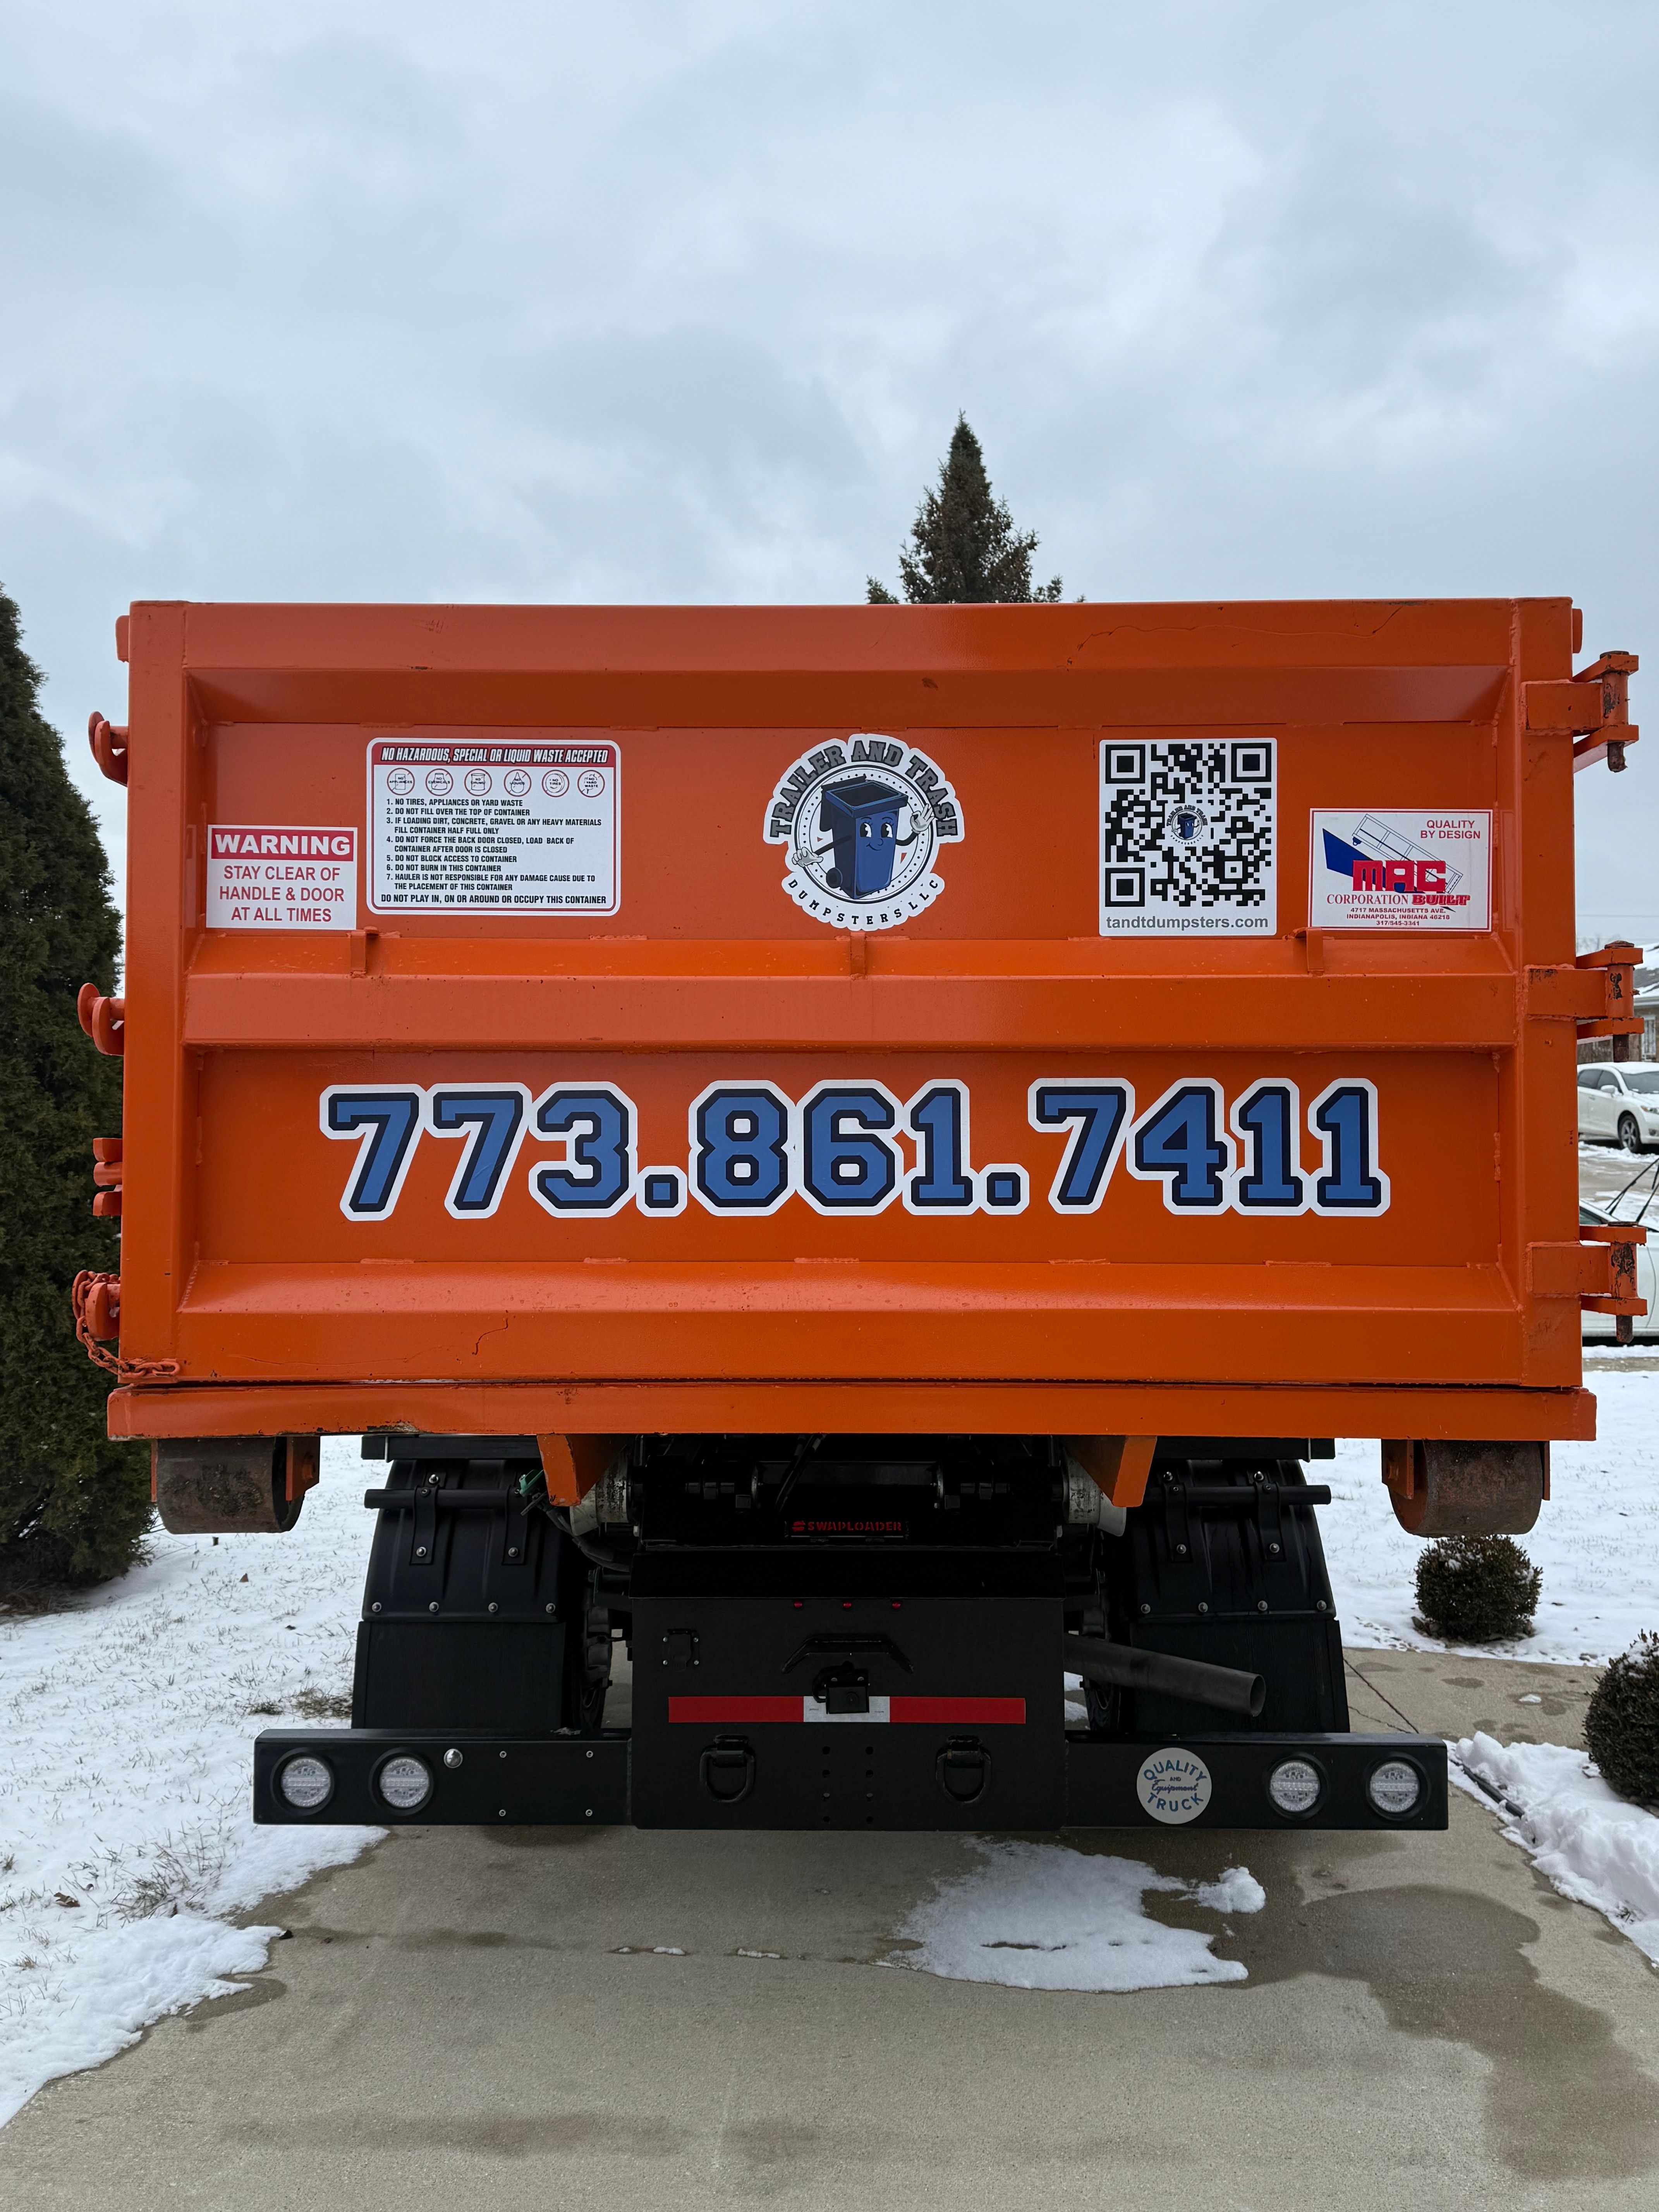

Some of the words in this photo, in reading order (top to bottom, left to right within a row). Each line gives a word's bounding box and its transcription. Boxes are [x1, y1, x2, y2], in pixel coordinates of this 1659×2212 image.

[381, 747, 395, 760] NO
[396, 747, 450, 763] HAZARDOUS,
[453, 749, 487, 761] SPECIAL
[489, 749, 503, 762] OR
[503, 749, 531, 763] LIQUID
[533, 749, 564, 763] WASTE
[565, 749, 608, 763] ACCEPTED
[770, 745, 847, 838] TRAILER
[851, 740, 903, 767] AND
[905, 755, 958, 837] TRASH
[452, 817, 488, 826] CONCRETE,
[1426, 819, 1475, 829] QUALITY
[1420, 830, 1436, 839] BY
[1439, 830, 1480, 839] DESIGN
[215, 834, 350, 855] WARNING
[223, 865, 261, 880] STAY
[265, 866, 316, 881] CLEAR
[320, 867, 340, 881] OF
[1352, 860, 1446, 892] MAC
[220, 886, 281, 900] HANDLE
[285, 887, 296, 901] &
[301, 887, 344, 902] DOOR
[381, 894, 391, 902] DO
[393, 894, 409, 902] NOT
[431, 895, 441, 904] IN,
[444, 895, 455, 903] ON
[457, 895, 467, 903] OR
[469, 895, 499, 903] AROUND
[514, 895, 544, 903] OCCUPY
[788, 879, 902, 924] DUMPSTERS
[908, 879, 939, 910] LLC
[1327, 894, 1408, 905] CORPORATION
[1412, 894, 1471, 906] BUILT
[231, 907, 251, 921] AT
[253, 907, 283, 921] ALL
[286, 907, 331, 922] TIMES
[1106, 915, 1268, 931] tandtdumpsters.com
[328, 1086, 1382, 1213] 773.861.7411
[808, 1522, 902, 1531] SWAPLOADER
[1144, 1760, 1207, 1781] QUALITY
[1152, 1779, 1199, 1795] Equipment
[1147, 1793, 1204, 1812] TRUCK
